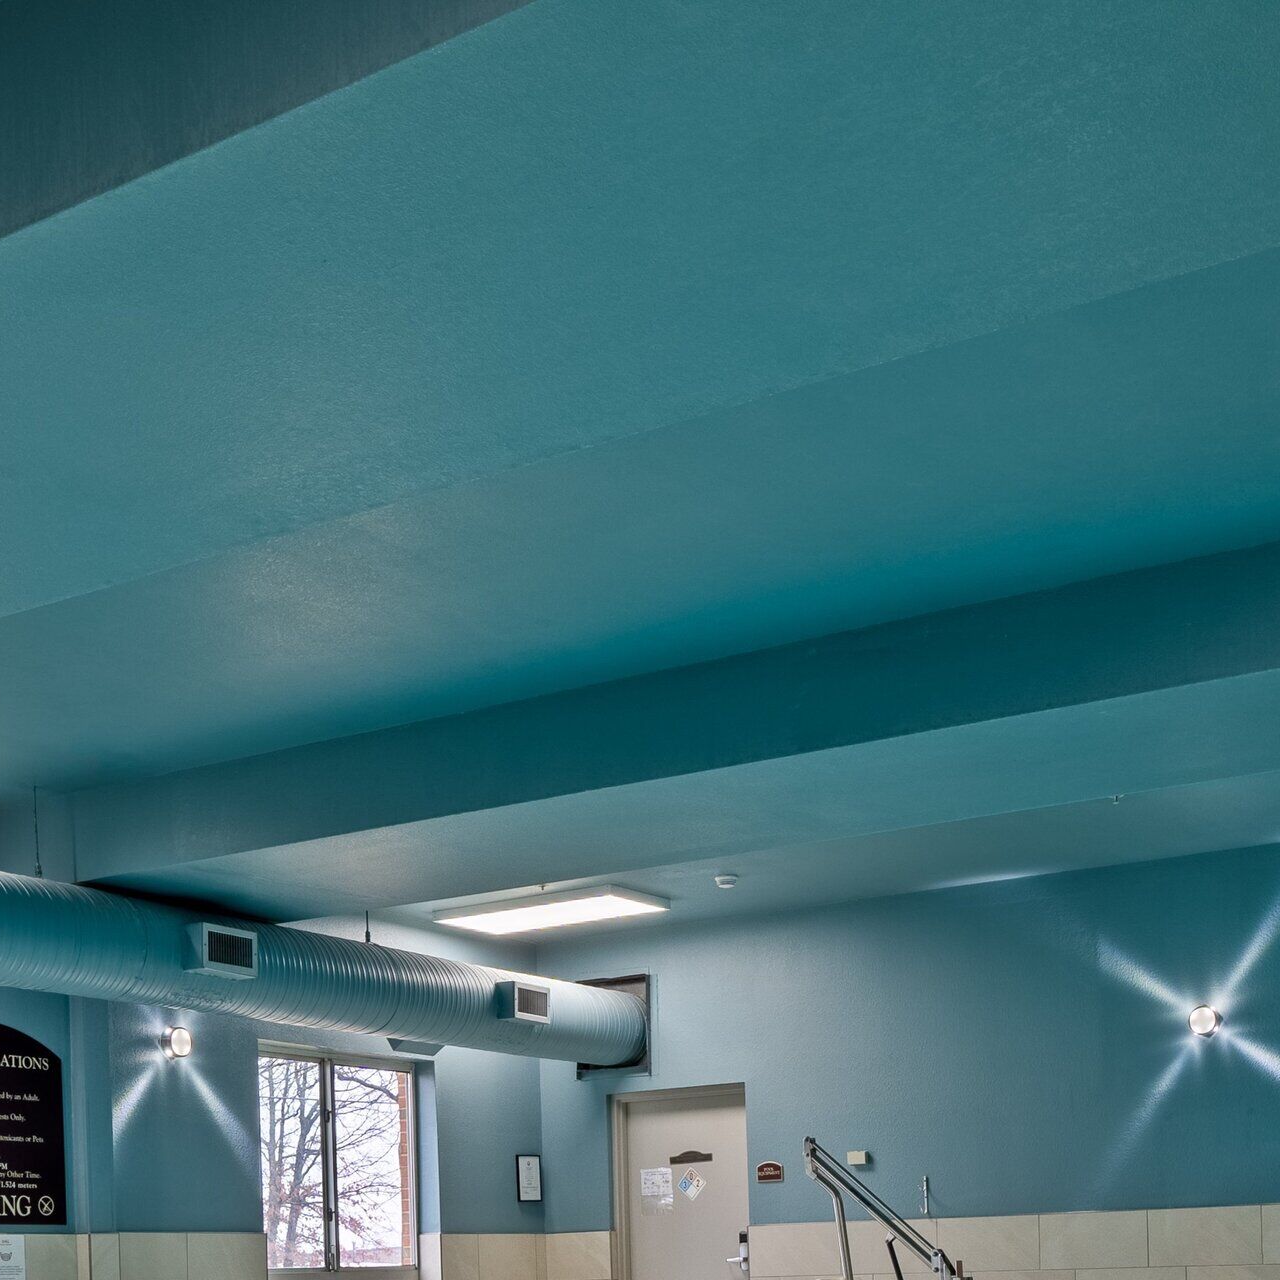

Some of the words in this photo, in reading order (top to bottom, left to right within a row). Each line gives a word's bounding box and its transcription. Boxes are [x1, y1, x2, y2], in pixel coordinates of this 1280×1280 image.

[6, 1092, 13, 1100] by
[32, 1135, 44, 1143] Pets
[7, 1170, 24, 1178] Other
